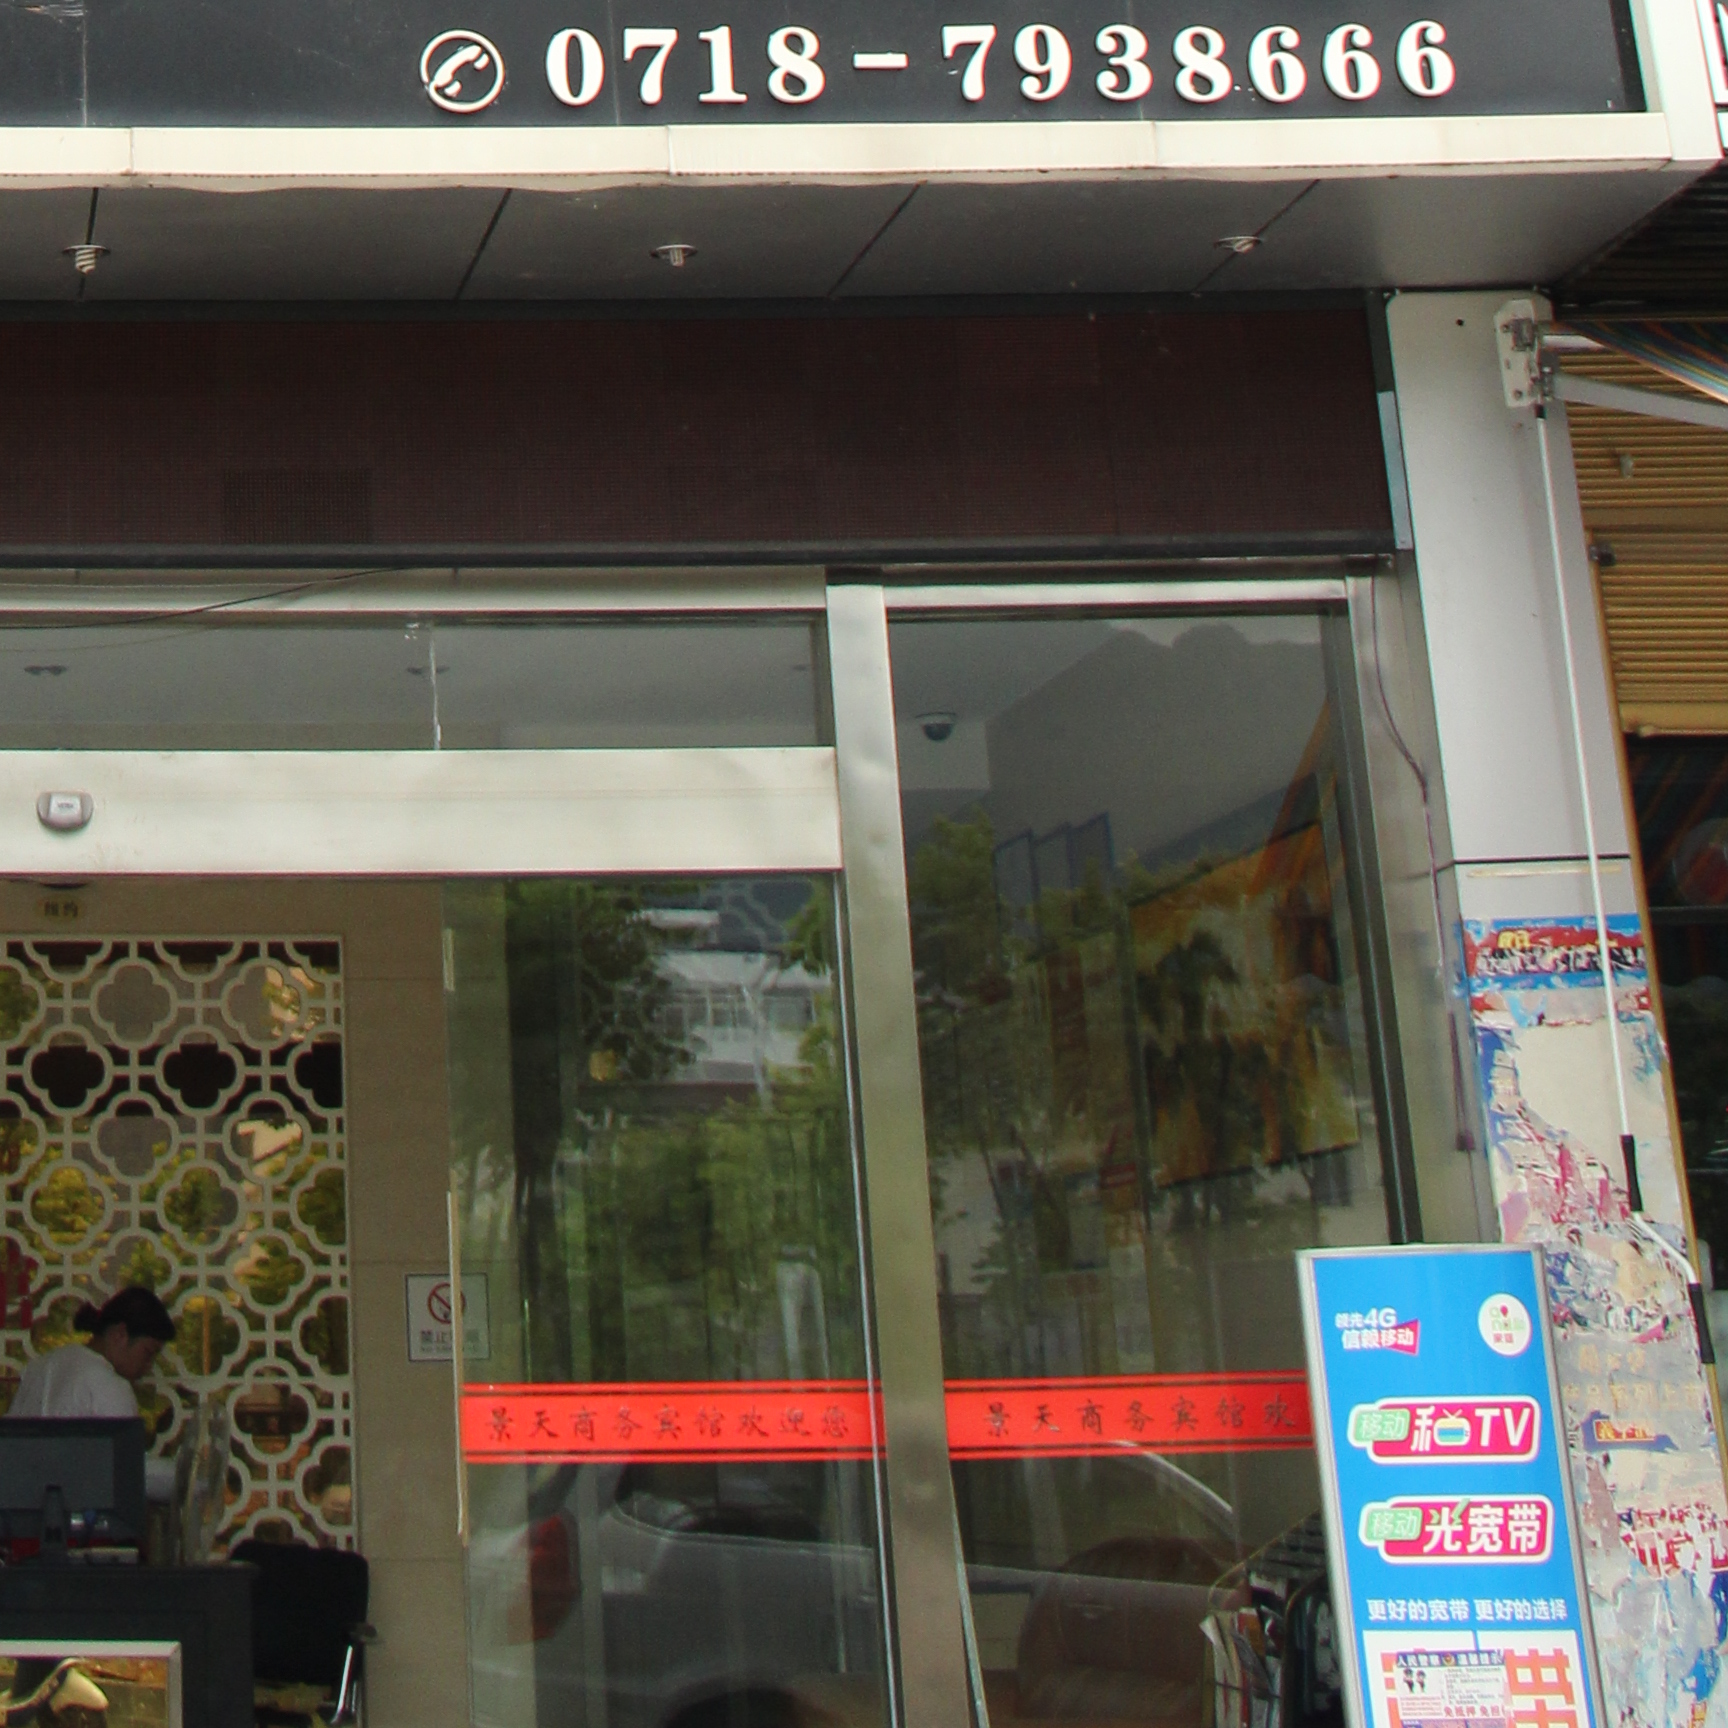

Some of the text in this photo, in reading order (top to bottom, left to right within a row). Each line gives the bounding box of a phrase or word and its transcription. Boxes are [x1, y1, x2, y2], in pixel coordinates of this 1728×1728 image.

[542, 20, 1459, 108] 0718-7938666
[483, 1404, 851, 1443] 景天商务宾馆欢迎您
[1359, 1412, 1408, 1439] 移动
[1372, 1497, 1543, 1554] 移动 光宽带
[1366, 1597, 1568, 1622] 更好的宽带 更好的选择
[1479, 1705, 1507, 1717] 免担
